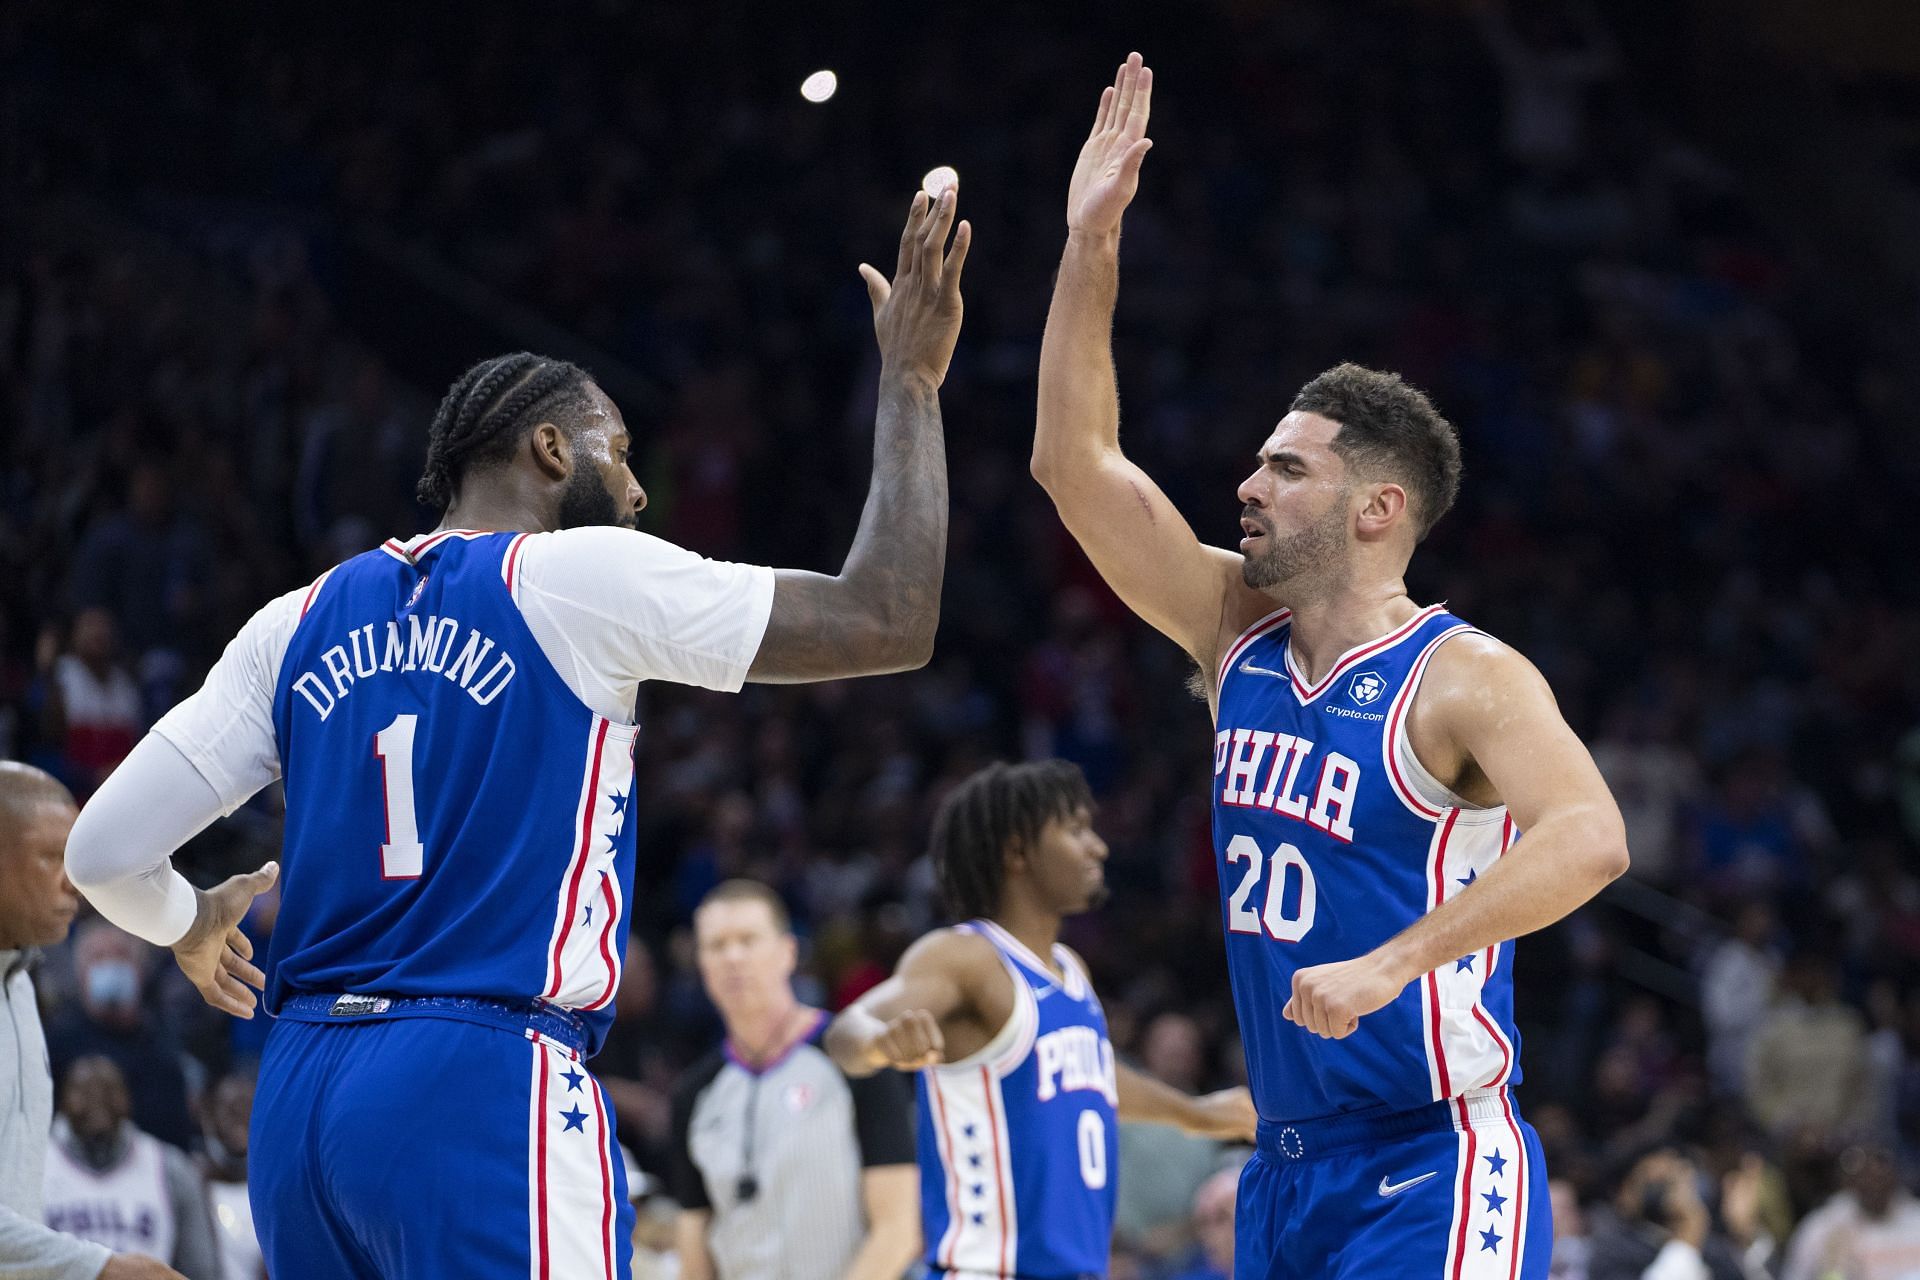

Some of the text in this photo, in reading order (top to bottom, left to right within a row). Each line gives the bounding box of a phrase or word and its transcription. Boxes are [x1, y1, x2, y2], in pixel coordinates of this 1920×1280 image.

[292, 615, 516, 722] DRUMMOND
[1326, 705, 1384, 721] crypto.com
[374, 714, 424, 880] 1
[1226, 834, 1316, 943] 20
[1077, 1109, 1107, 1189] 0
